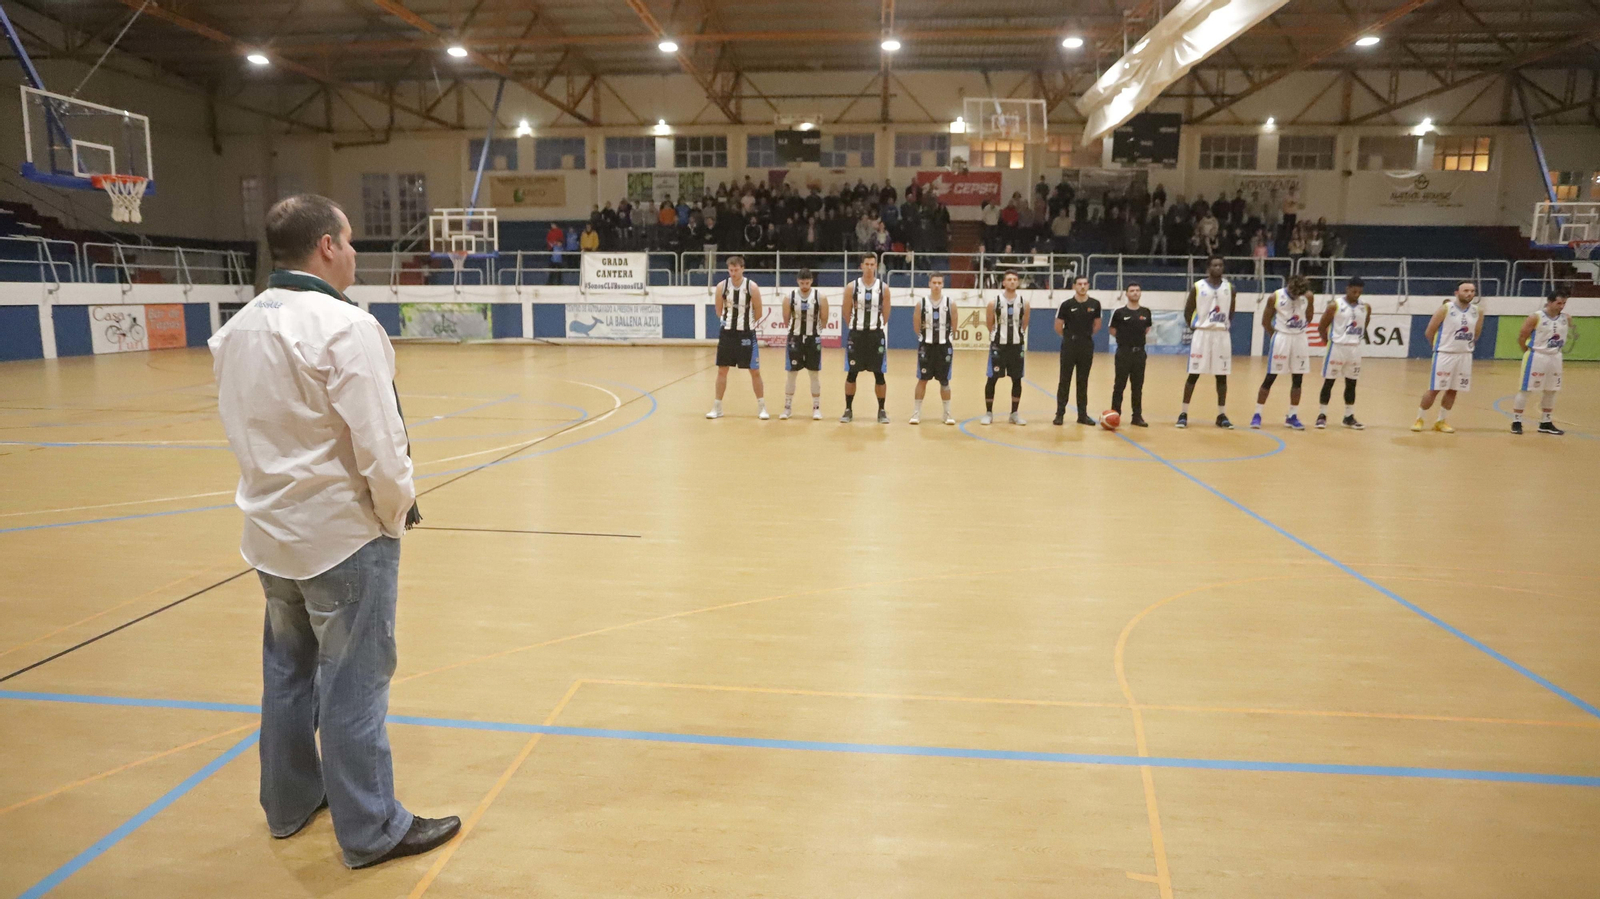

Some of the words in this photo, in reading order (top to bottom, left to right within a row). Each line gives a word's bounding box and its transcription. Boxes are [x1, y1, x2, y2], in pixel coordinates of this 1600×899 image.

[953, 182, 998, 194] CEPSA
[601, 257, 628, 266] GRADA
[596, 269, 633, 278] CANTERA
[92, 306, 126, 322] Casa
[606, 315, 613, 327] LA
[614, 315, 642, 327] BALLENA
[643, 316, 660, 327] AZUL
[975, 331, 982, 341] e
